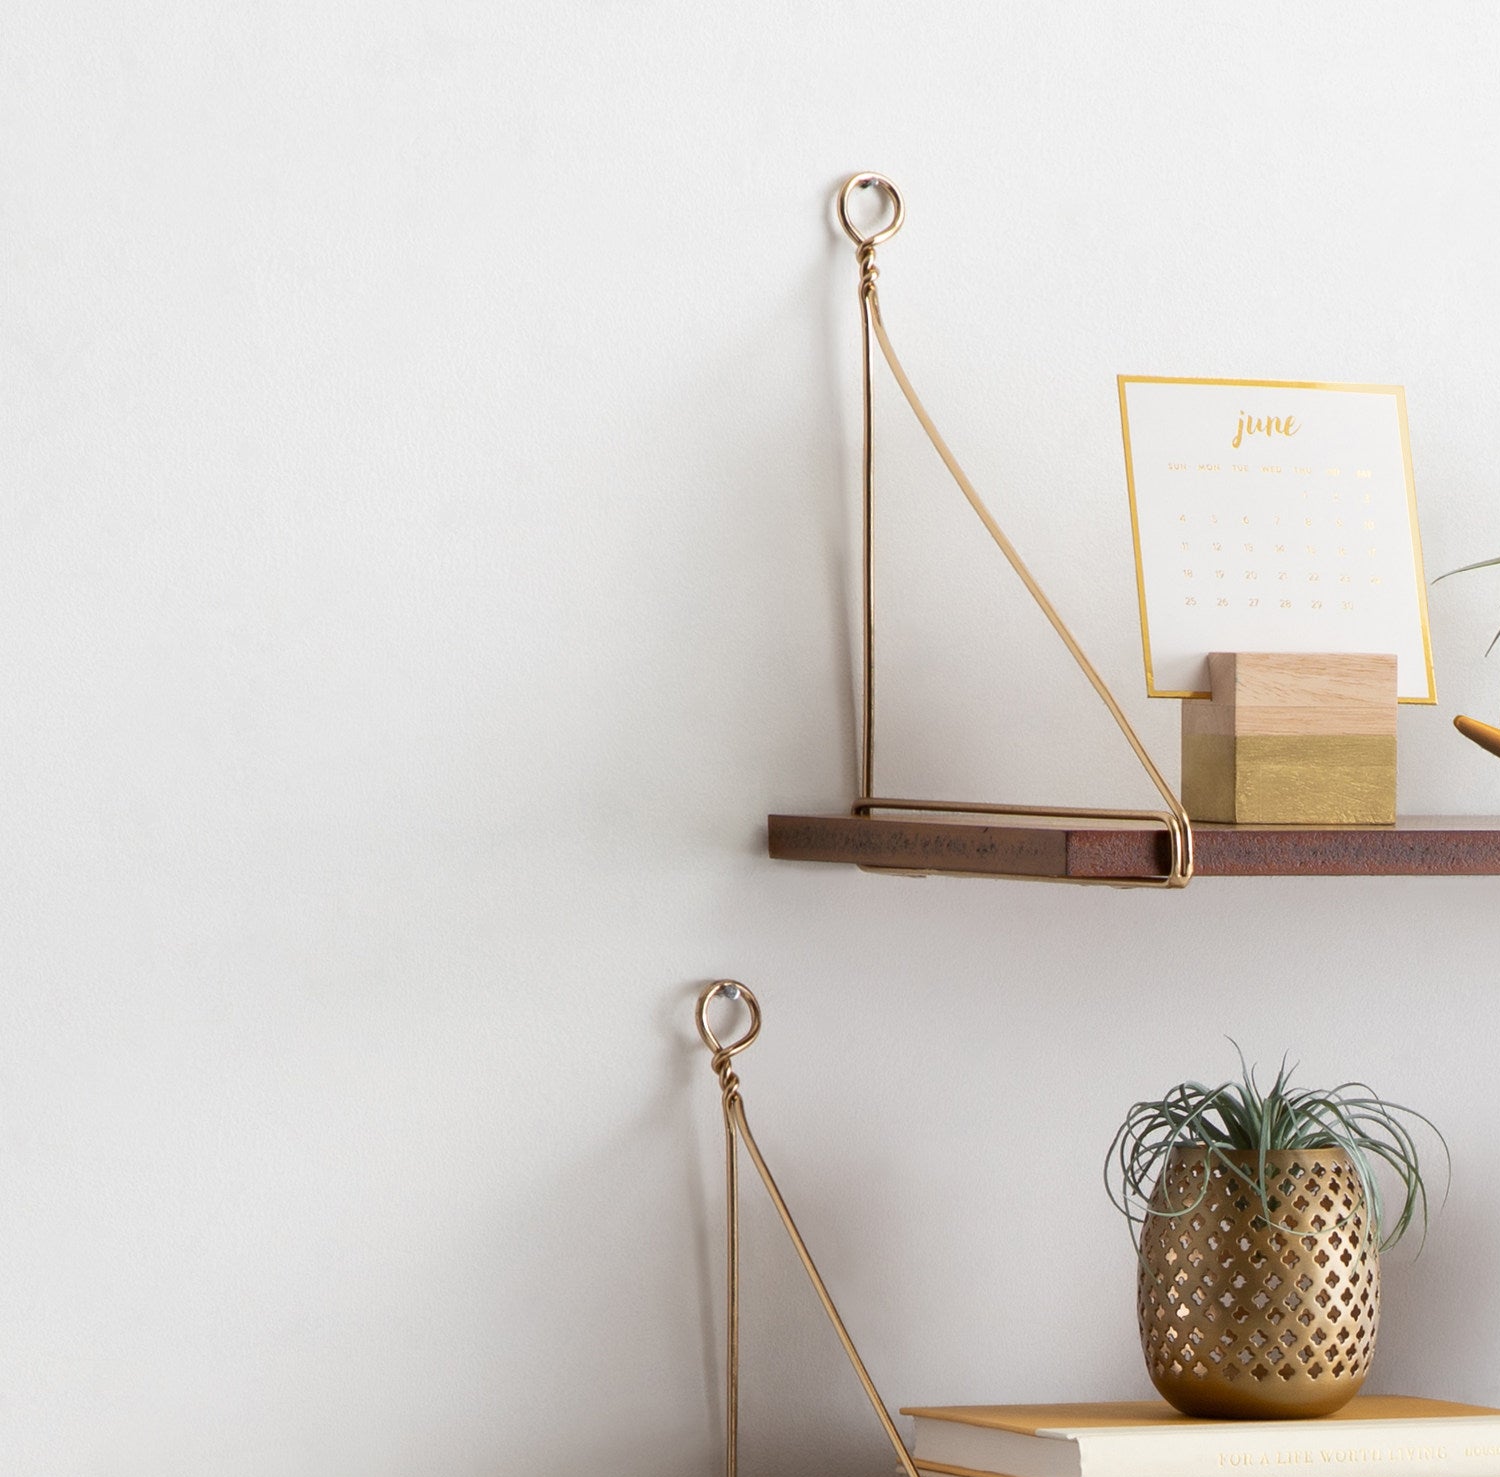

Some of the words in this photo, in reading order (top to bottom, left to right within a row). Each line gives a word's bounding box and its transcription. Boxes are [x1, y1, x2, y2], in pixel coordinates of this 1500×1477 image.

[1232, 409, 1302, 448] june
[1168, 463, 1187, 471] SUN
[1198, 464, 1220, 472] MON
[1232, 464, 1248, 472] TUE
[1260, 465, 1282, 473] WED
[1293, 466, 1312, 475] THU
[1179, 513, 1187, 523] 4
[1242, 515, 1250, 525] 6
[1304, 517, 1312, 527] 8
[1183, 569, 1193, 578] 18
[1215, 569, 1225, 579] 19
[1245, 570, 1258, 580] 20
[1308, 572, 1319, 581] 22
[1185, 597, 1197, 606] 25
[1217, 598, 1229, 607] 26
[1248, 598, 1259, 607] 27
[1280, 599, 1291, 608] 28
[1311, 600, 1322, 609] 29
[1218, 1453, 1254, 1467] FOR
[1259, 1452, 1270, 1466] A
[1277, 1451, 1313, 1465] LIFE
[1320, 1448, 1382, 1463] WORTH
[1389, 1446, 1448, 1461] LIVING
